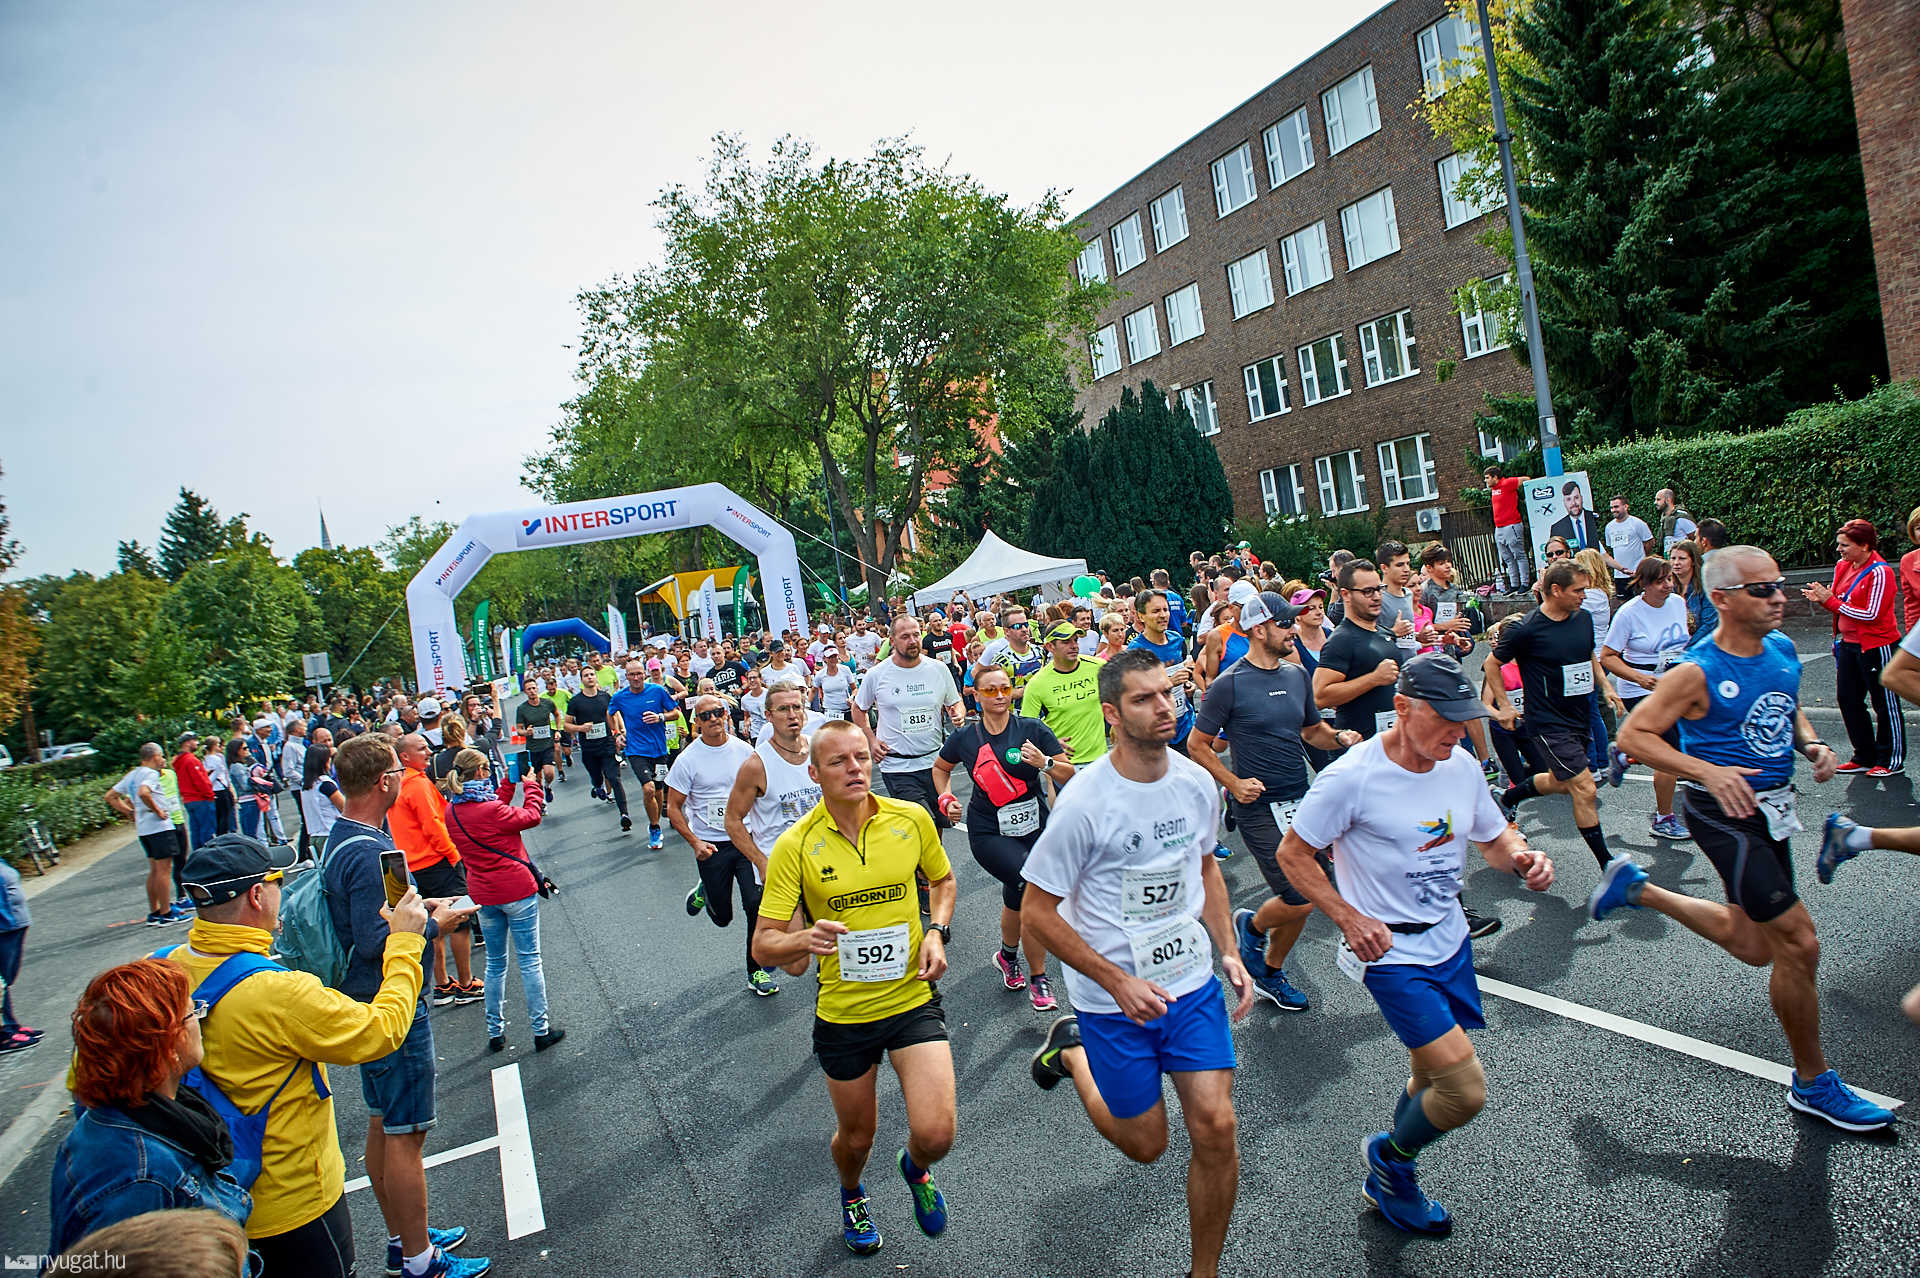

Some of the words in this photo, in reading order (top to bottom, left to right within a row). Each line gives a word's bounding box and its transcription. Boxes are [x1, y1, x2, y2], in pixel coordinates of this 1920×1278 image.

[545, 500, 679, 534] INTERSPORT
[731, 509, 772, 538] INTERSPORT
[440, 540, 476, 581] INTERSPORT
[782, 576, 798, 633] NTERSPORT
[429, 630, 447, 698] INTERSPORT
[906, 683, 925, 692] team
[1574, 671, 1590, 685] 543
[909, 714, 926, 725] 818
[1010, 811, 1030, 825] 833
[1153, 817, 1187, 840] team
[850, 889, 886, 904] HORN
[1142, 881, 1180, 905] 527
[857, 943, 895, 965] 592
[1152, 937, 1185, 965] 802
